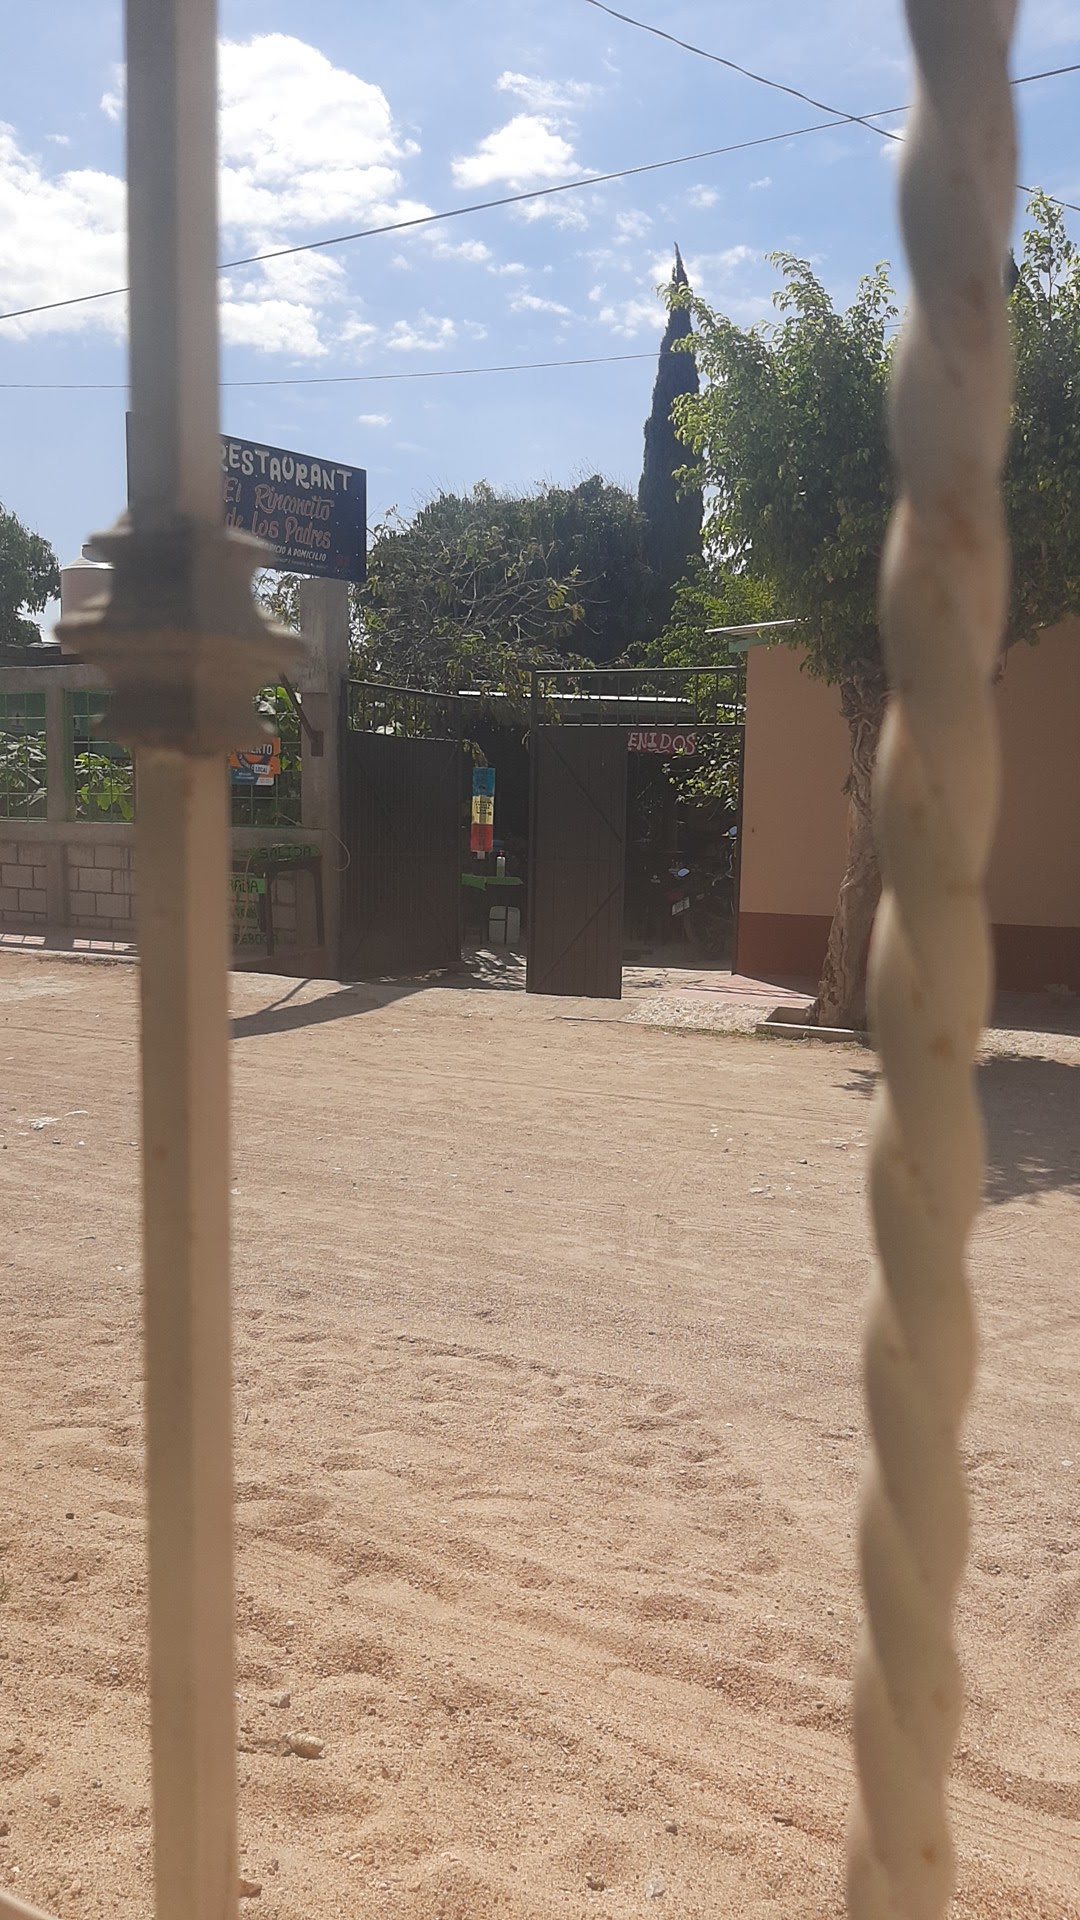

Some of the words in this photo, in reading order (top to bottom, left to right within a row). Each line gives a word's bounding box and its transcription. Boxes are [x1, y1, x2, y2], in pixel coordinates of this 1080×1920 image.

[223, 475, 242, 503] El
[255, 484, 335, 521] Rinconcito
[285, 516, 332, 549] Padres
[293, 548, 327, 562] DOMICILIO
[628, 732, 695, 755] ENIDOS
